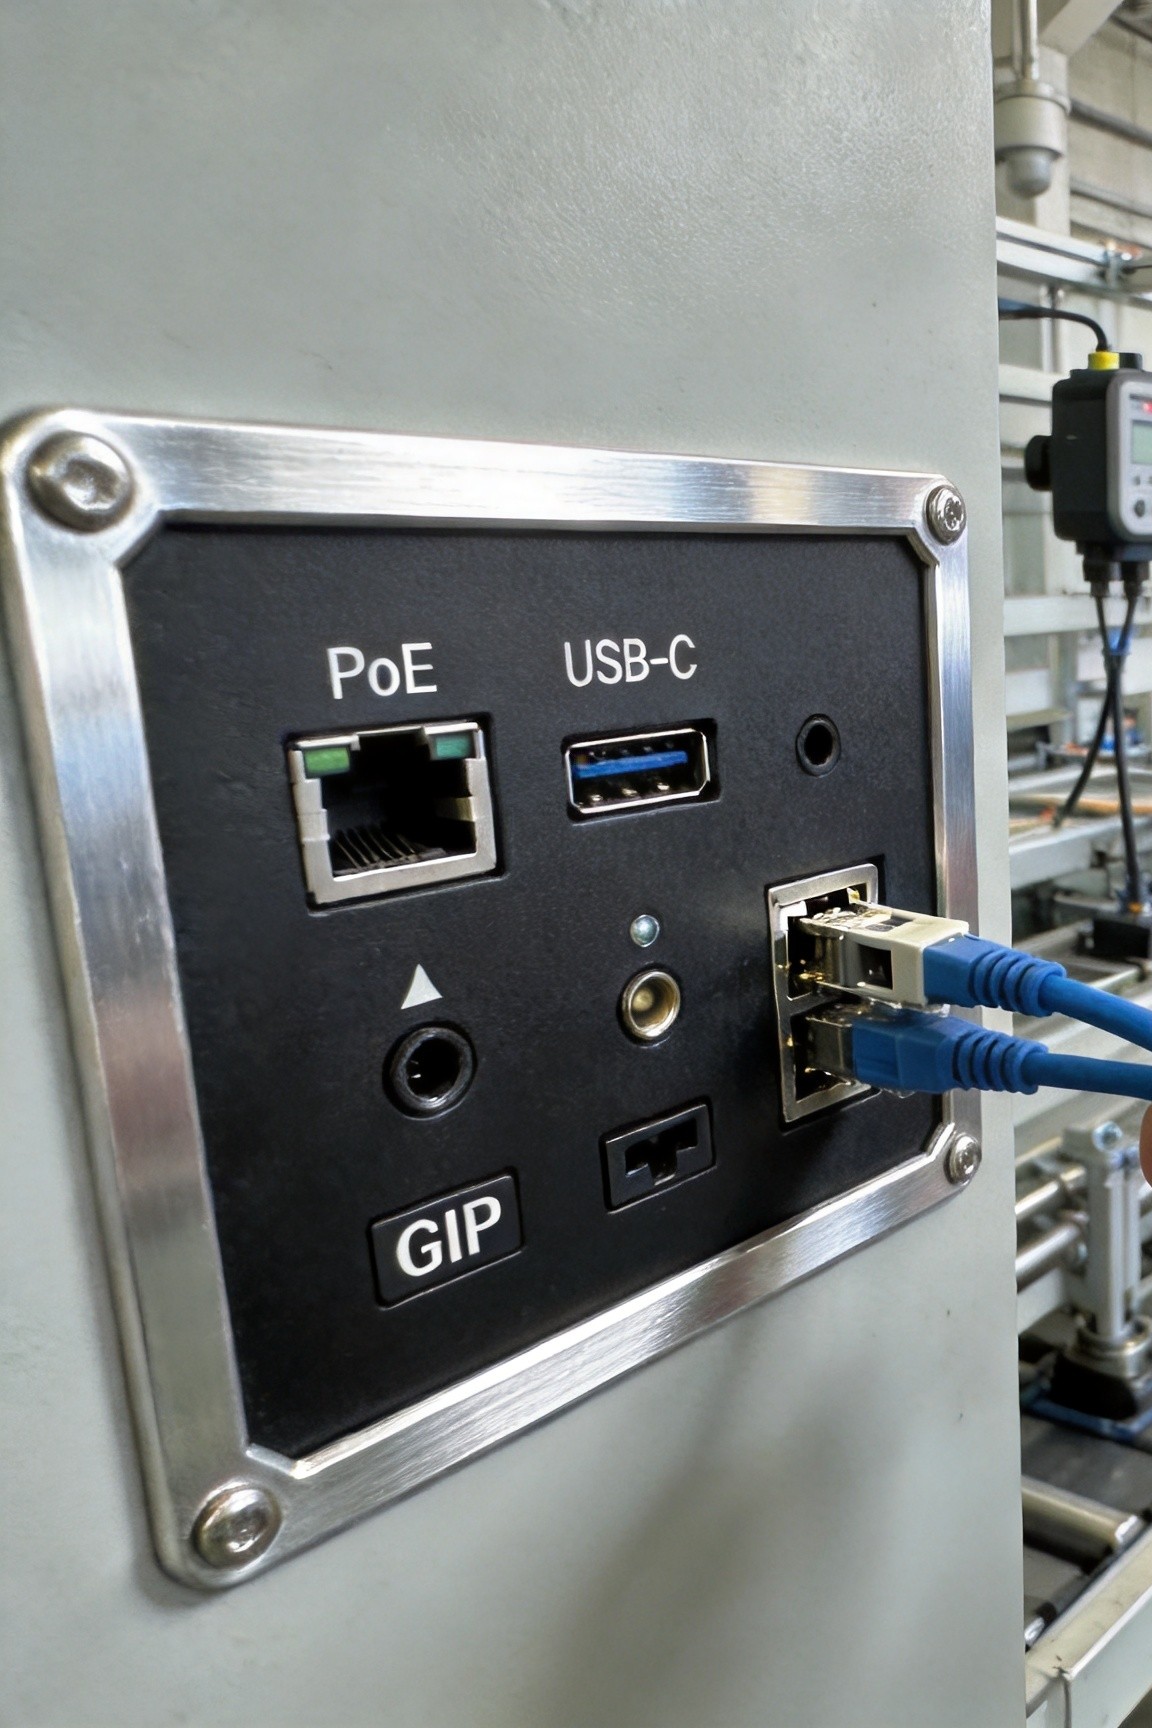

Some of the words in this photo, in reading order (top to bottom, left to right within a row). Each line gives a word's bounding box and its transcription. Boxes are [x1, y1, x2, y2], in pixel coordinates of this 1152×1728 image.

[326, 641, 438, 700] PoE
[563, 633, 698, 688] USB-C
[395, 1195, 502, 1277] GIP
